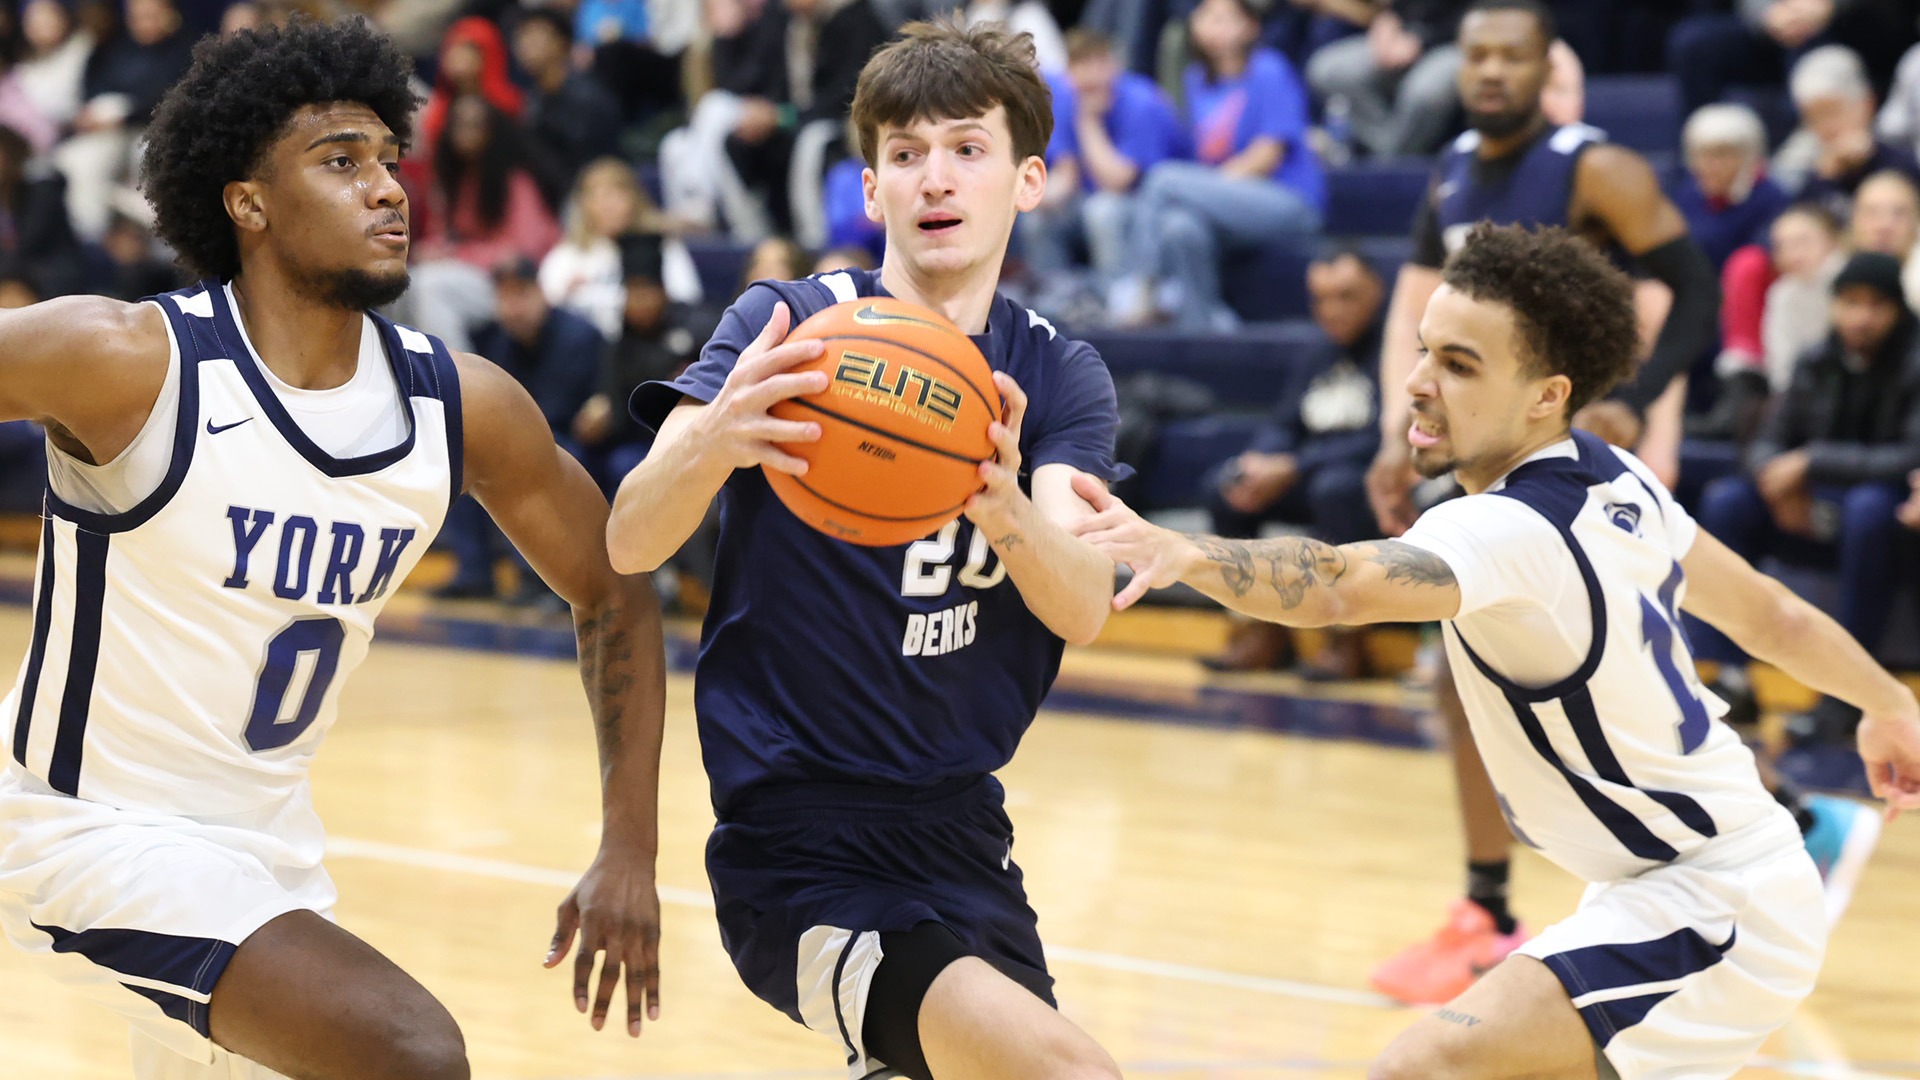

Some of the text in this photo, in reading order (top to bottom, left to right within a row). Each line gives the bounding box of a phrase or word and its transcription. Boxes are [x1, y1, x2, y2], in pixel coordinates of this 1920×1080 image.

[834, 350, 963, 424] ELITE
[221, 503, 416, 605] YORK
[902, 600, 979, 657] BERKS
[239, 613, 348, 755] 0
